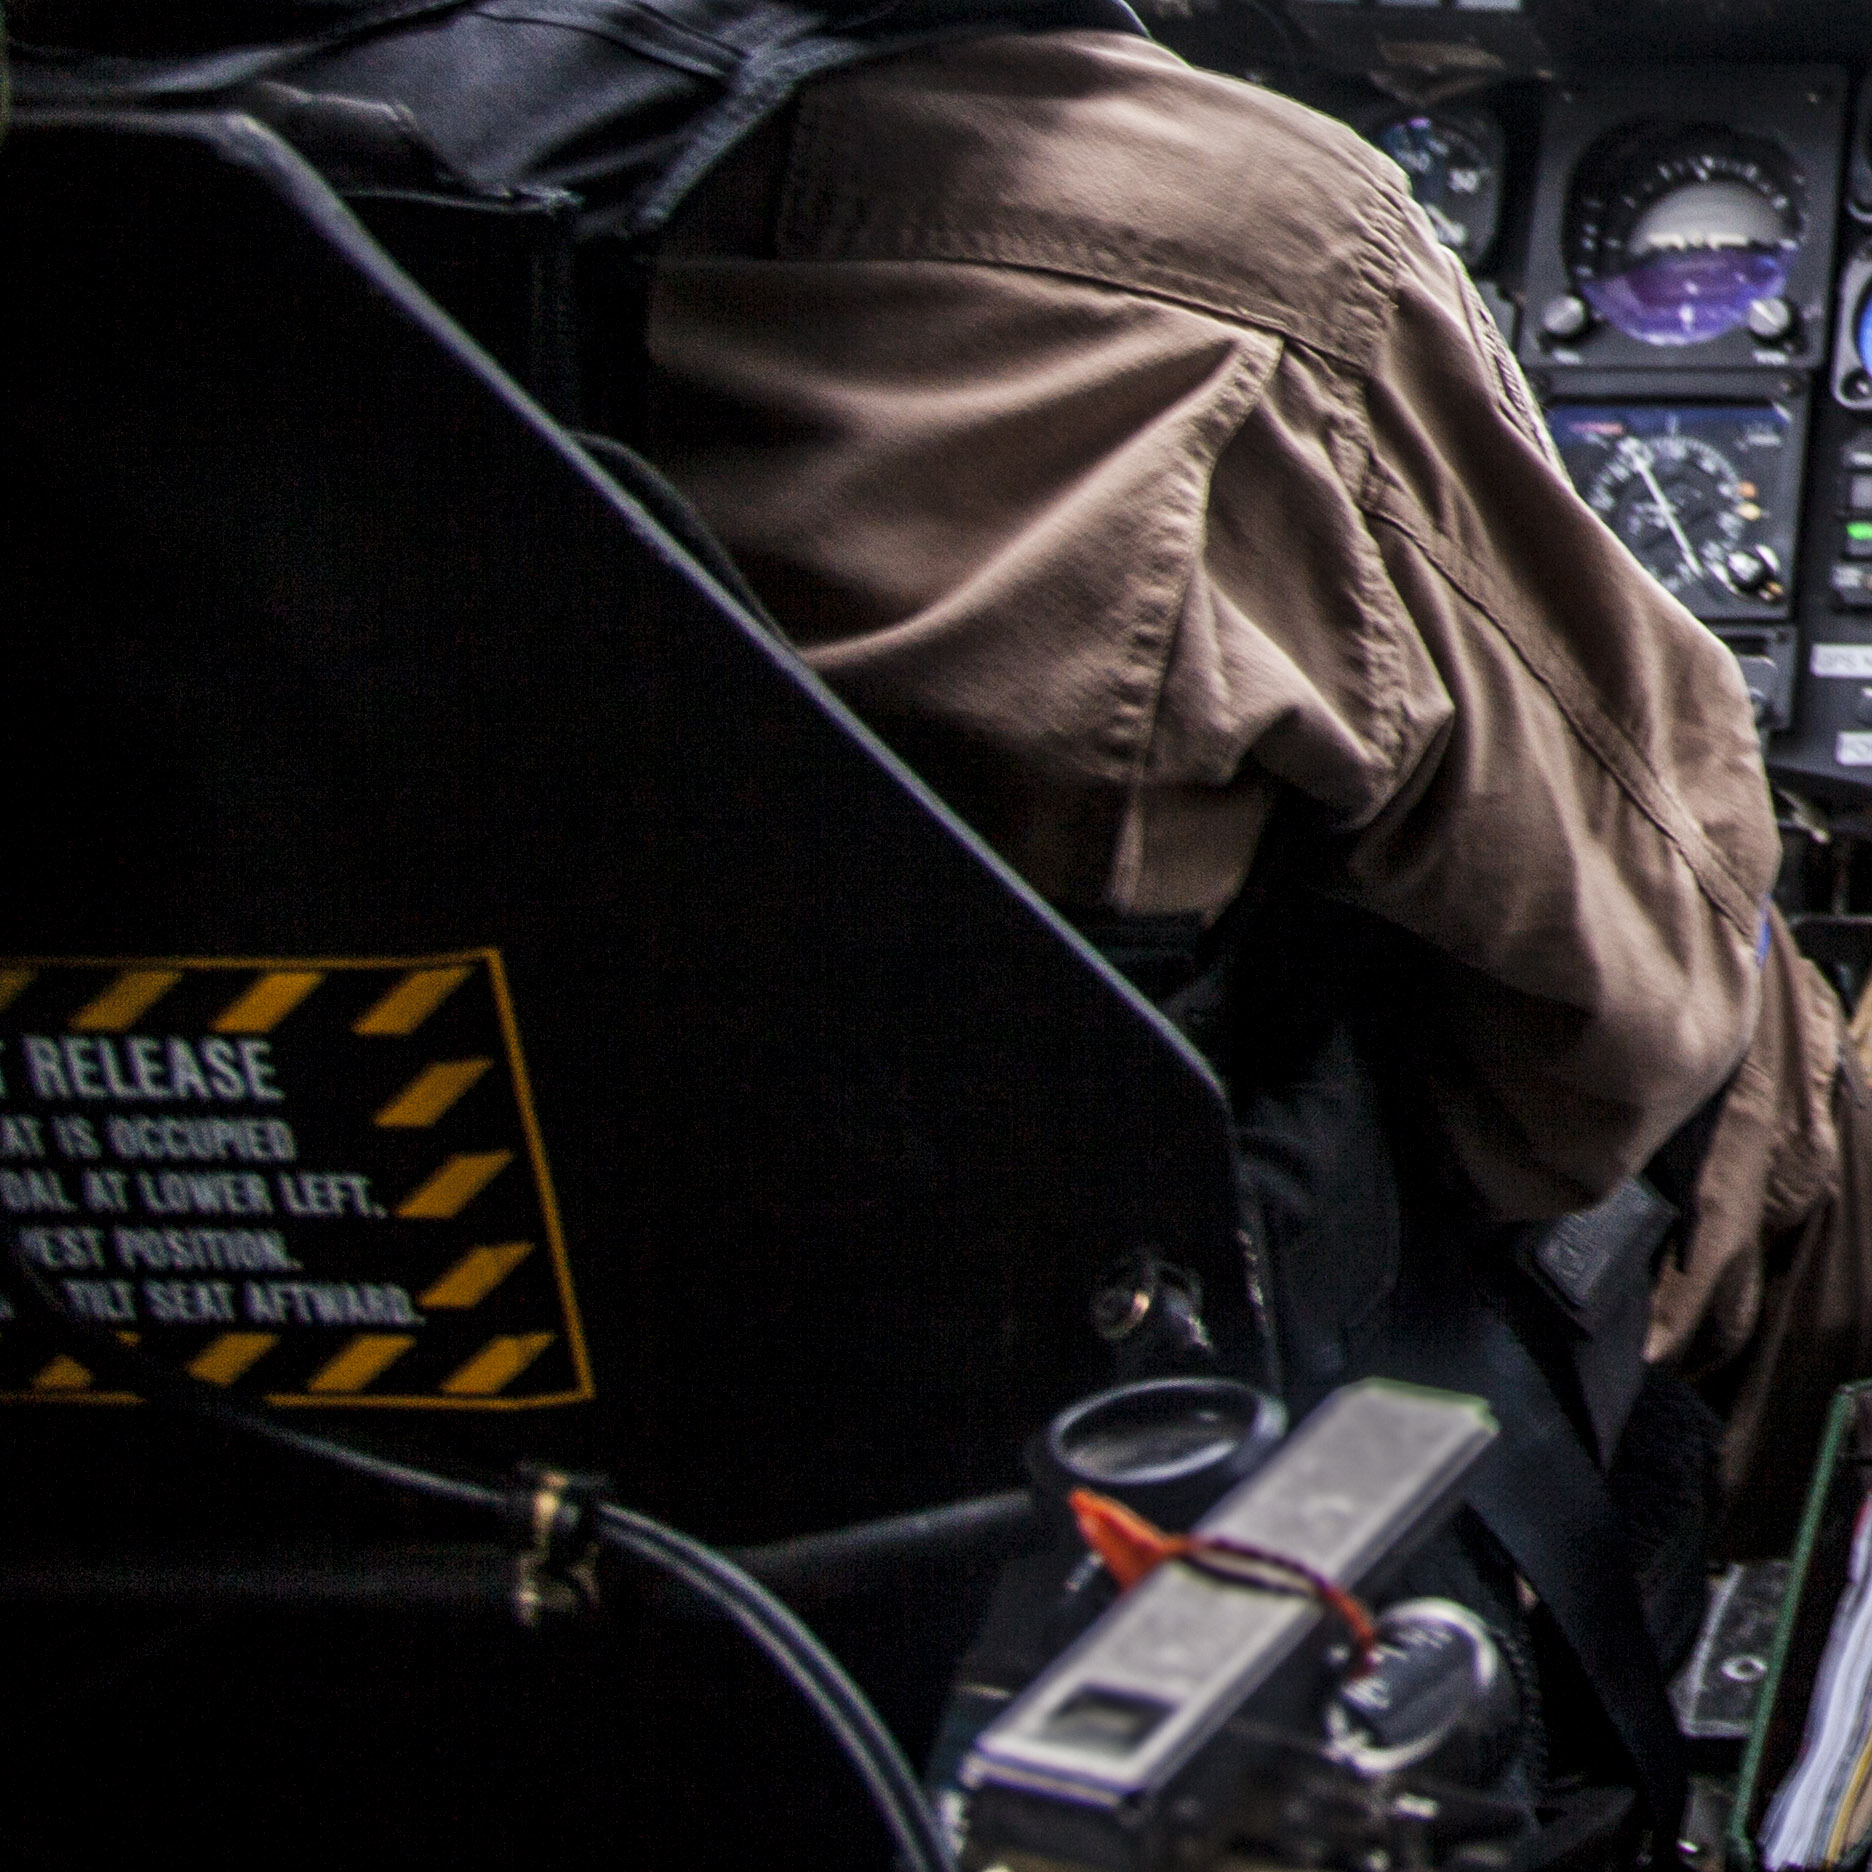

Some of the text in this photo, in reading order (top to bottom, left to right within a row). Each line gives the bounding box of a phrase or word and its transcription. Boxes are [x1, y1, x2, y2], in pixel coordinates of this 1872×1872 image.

[21, 1035, 286, 1103] RELEASE
[51, 1116, 103, 1159] IS
[107, 1117, 299, 1163] OCCUPIED
[81, 1170, 130, 1213] AT
[137, 1170, 274, 1215] LOWER
[278, 1171, 388, 1219] LEFT.
[112, 1227, 304, 1272] POSITION.
[60, 1277, 428, 1328] TILT SEAT AFTWARD.
